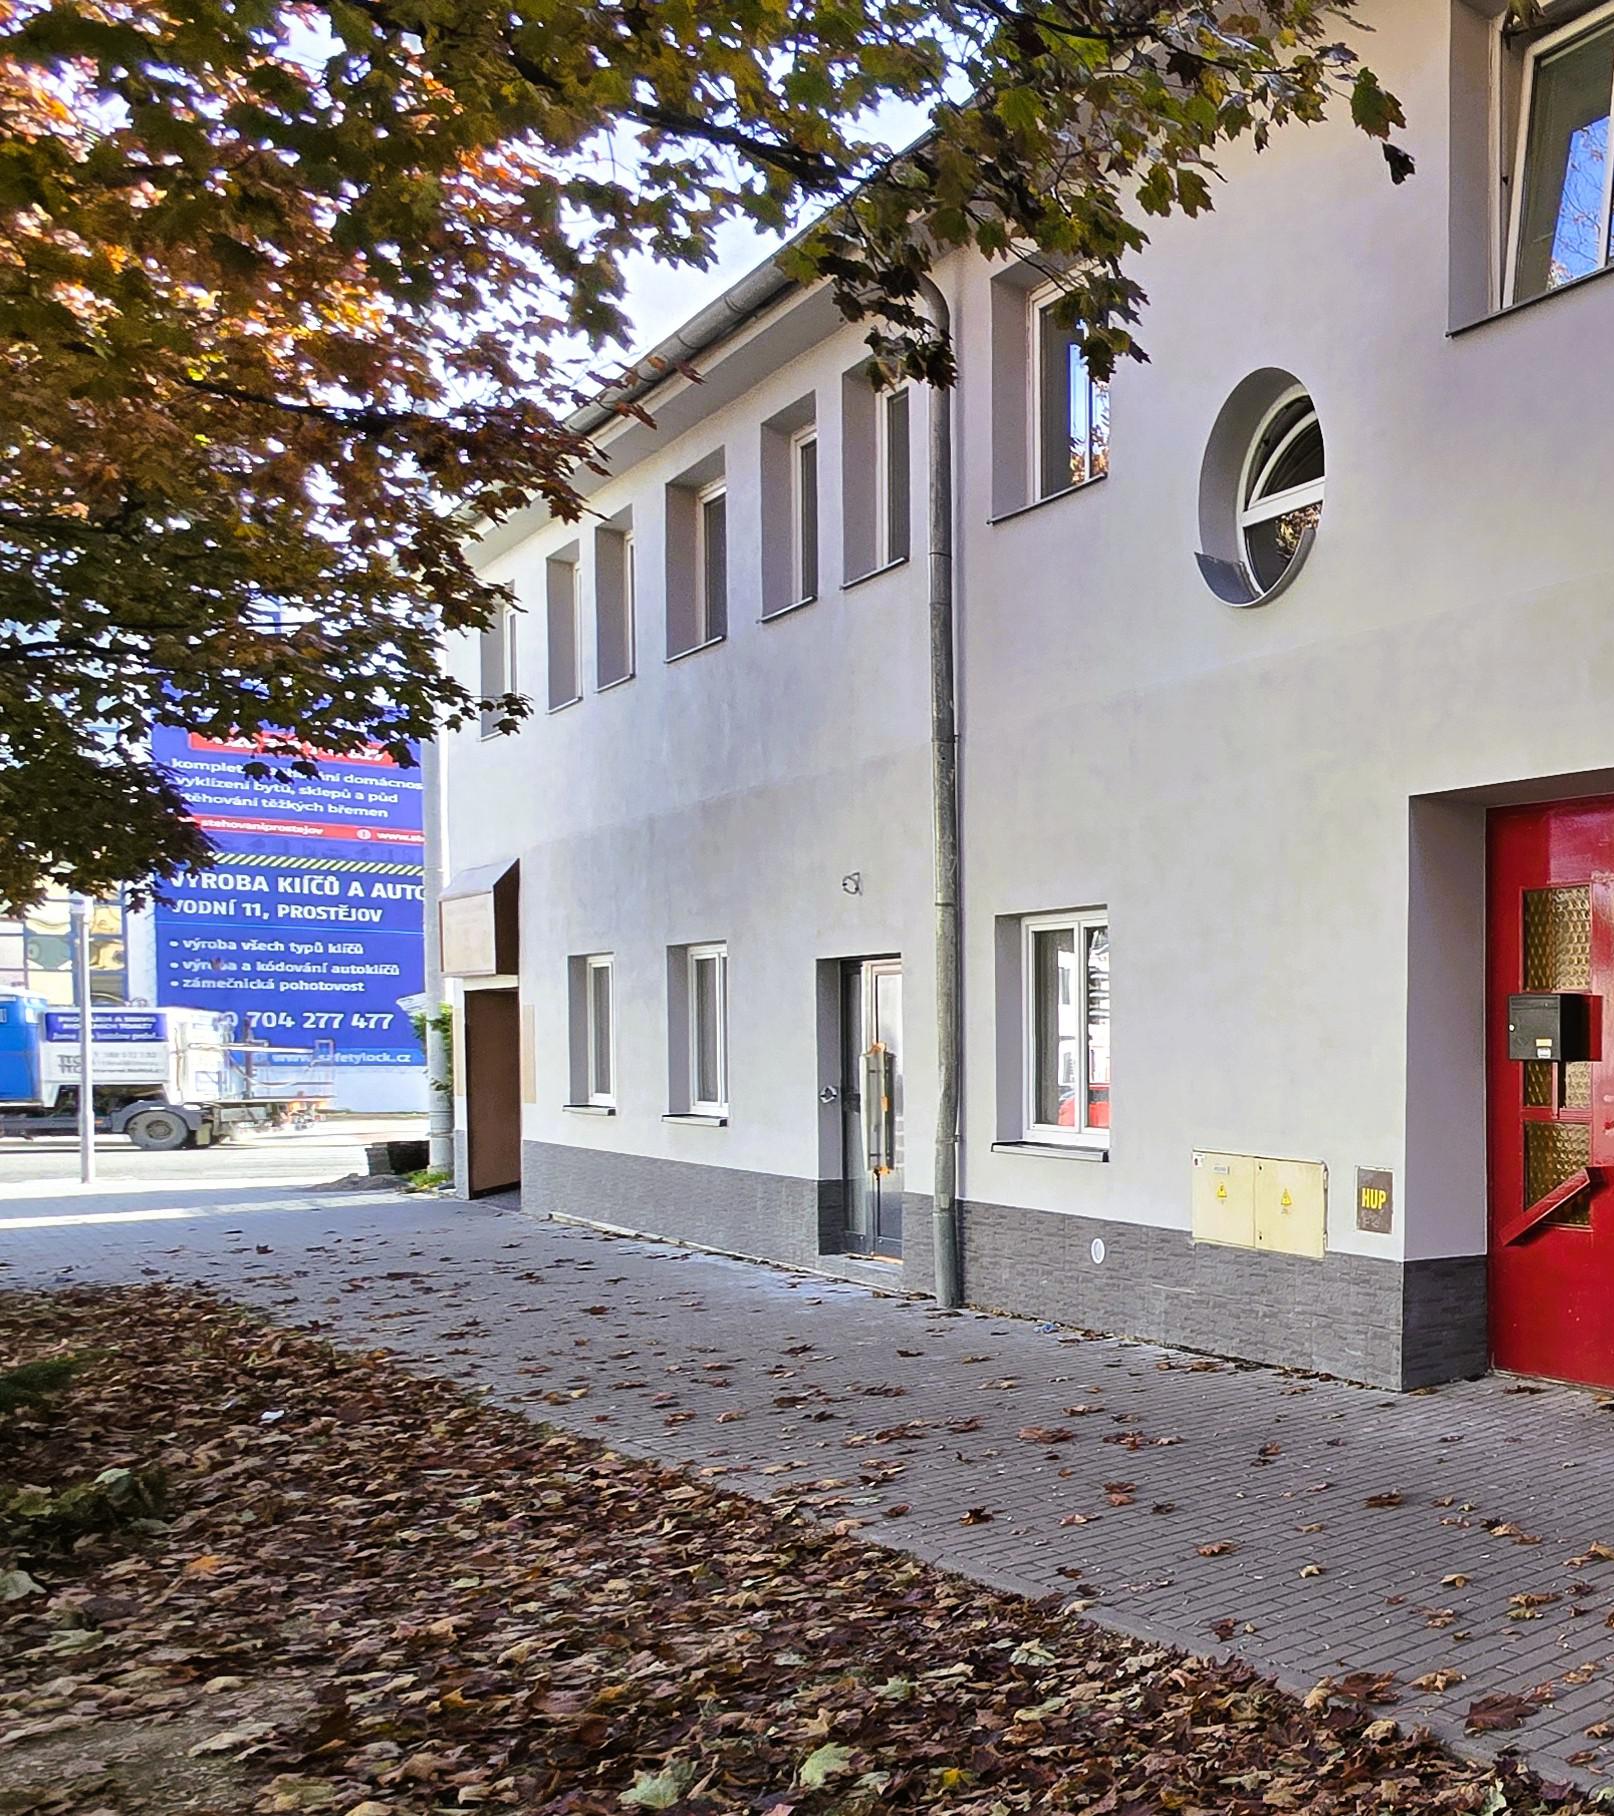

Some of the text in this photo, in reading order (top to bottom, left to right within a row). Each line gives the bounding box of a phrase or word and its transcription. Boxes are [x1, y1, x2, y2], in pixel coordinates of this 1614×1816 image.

[175, 776, 250, 791] vyklízení
[298, 786, 352, 801] sklepů
[354, 792, 365, 800] a
[367, 791, 398, 803] půd
[328, 803, 389, 818] břemen
[347, 882, 365, 898] A
[241, 903, 270, 920] 11,
[277, 902, 383, 923] PROSTĚJOV
[182, 937, 237, 952] výroba
[241, 939, 284, 952] všech
[289, 941, 324, 955] typů
[241, 962, 251, 971] a
[256, 960, 328, 973] kódování
[331, 963, 400, 976] autoklíčů
[182, 977, 365, 992] zámečnická pohotovost
[246, 1011, 295, 1028] 704
[302, 1012, 345, 1029] 277
[351, 1013, 394, 1030] 477
[1361, 1187, 1387, 1210] HUP
